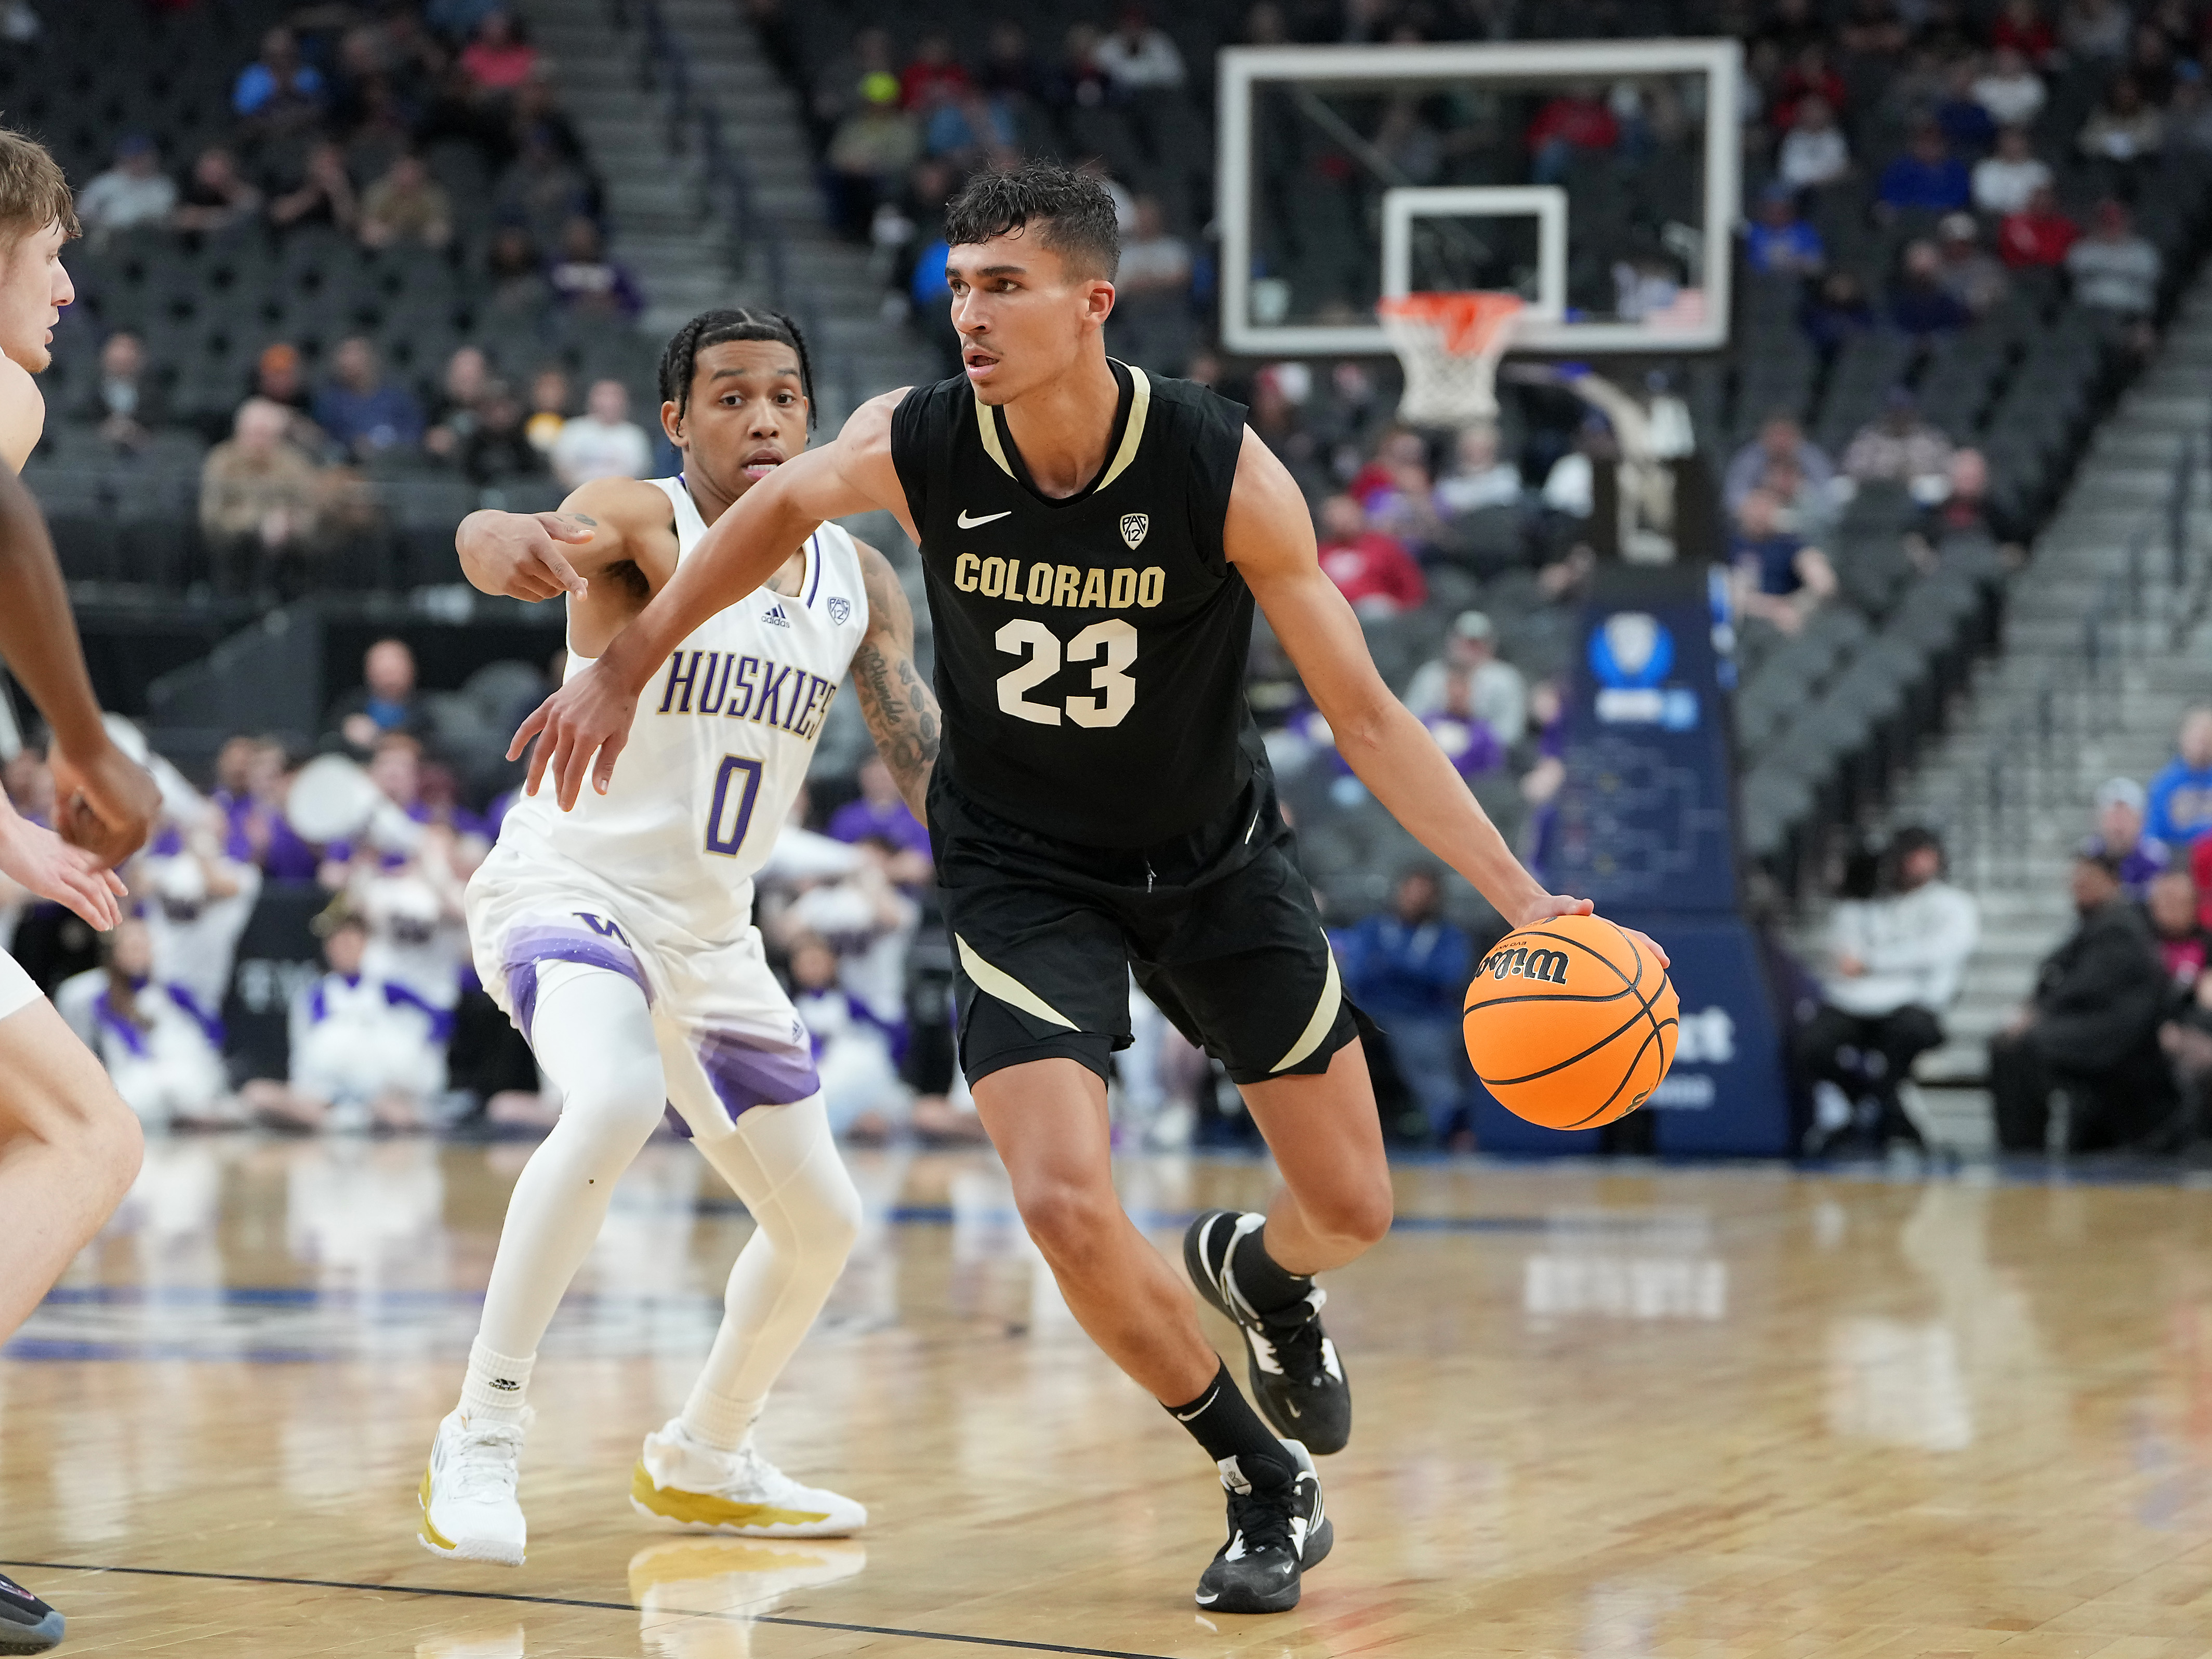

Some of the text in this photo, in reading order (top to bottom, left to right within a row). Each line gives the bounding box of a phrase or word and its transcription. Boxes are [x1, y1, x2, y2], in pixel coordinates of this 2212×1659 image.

[1122, 515, 1146, 536] PAC
[1128, 529, 1141, 542] 12
[955, 553, 1165, 608] COLORADO
[829, 598, 849, 614] PAC
[833, 610, 844, 620] 12
[761, 615, 790, 628] adidas
[995, 618, 1137, 727] 23
[704, 753, 765, 858] 0
[1494, 944, 1509, 952] NXT
[1471, 947, 1569, 986] Wilso
